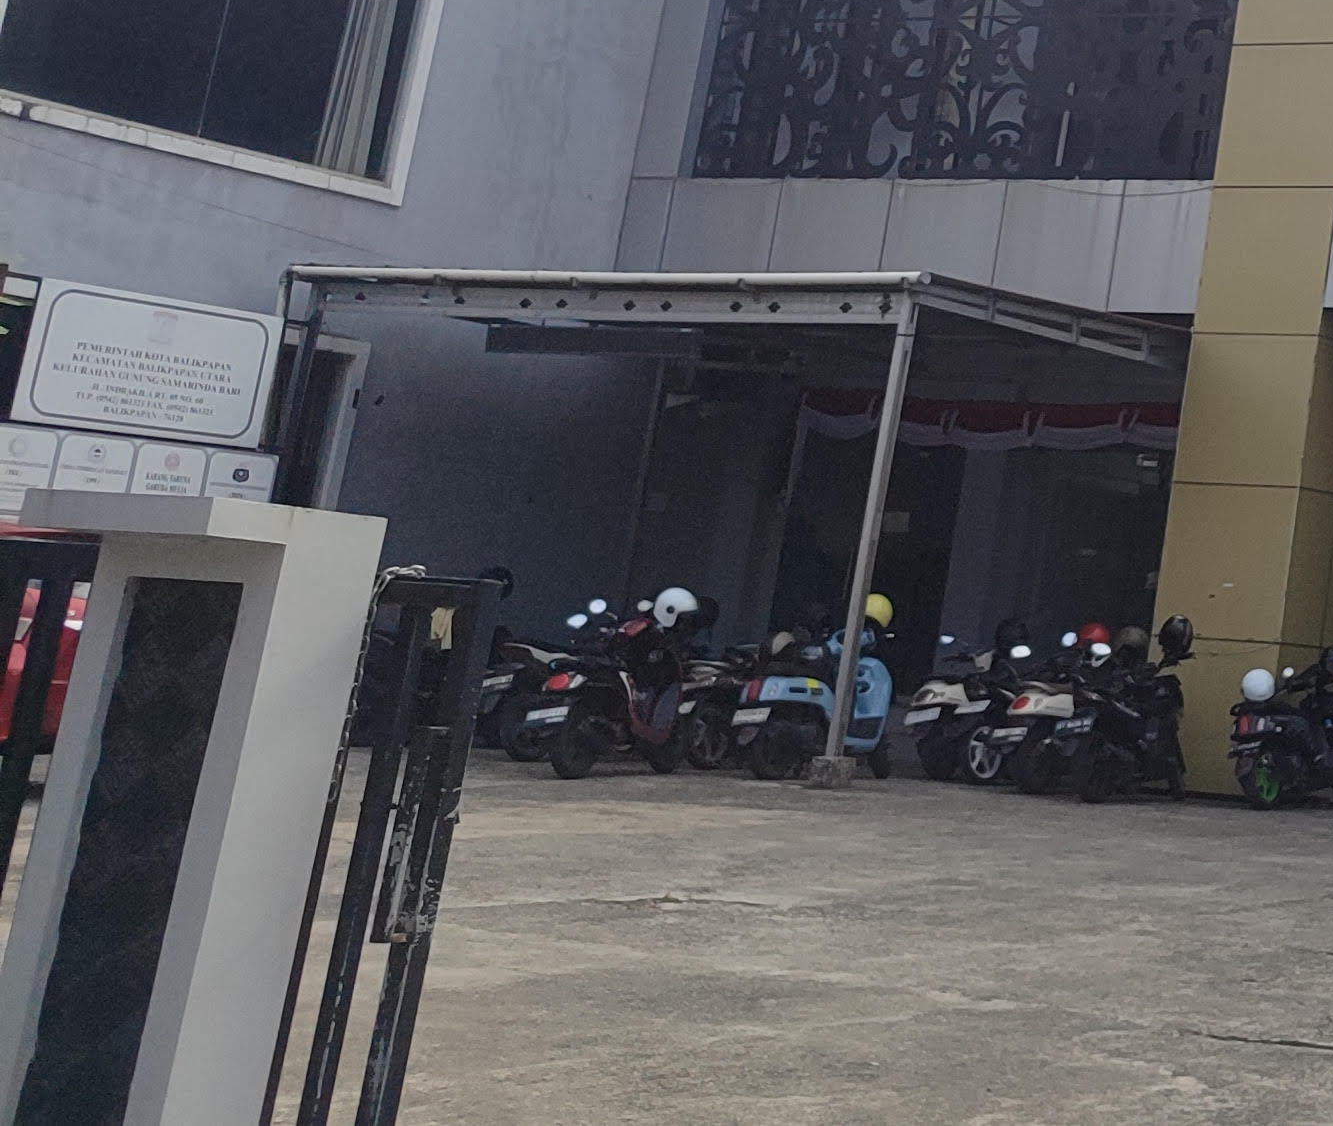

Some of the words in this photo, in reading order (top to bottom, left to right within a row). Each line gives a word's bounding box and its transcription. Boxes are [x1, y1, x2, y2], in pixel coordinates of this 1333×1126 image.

[72, 353, 136, 369] KECAMATAN
[138, 362, 198, 378] BALIKPAPAN
[200, 372, 231, 384] UTARA
[77, 341, 143, 359] PEMERINTAH
[144, 351, 171, 363] KOTA
[173, 356, 232, 371] BALIKPAPAN
[52, 362, 116, 378] KELURAHAN
[118, 372, 159, 385] GUNUNG
[161, 378, 217, 393] SAMARINDA
[103, 406, 157, 419] BALIKPAPAN
